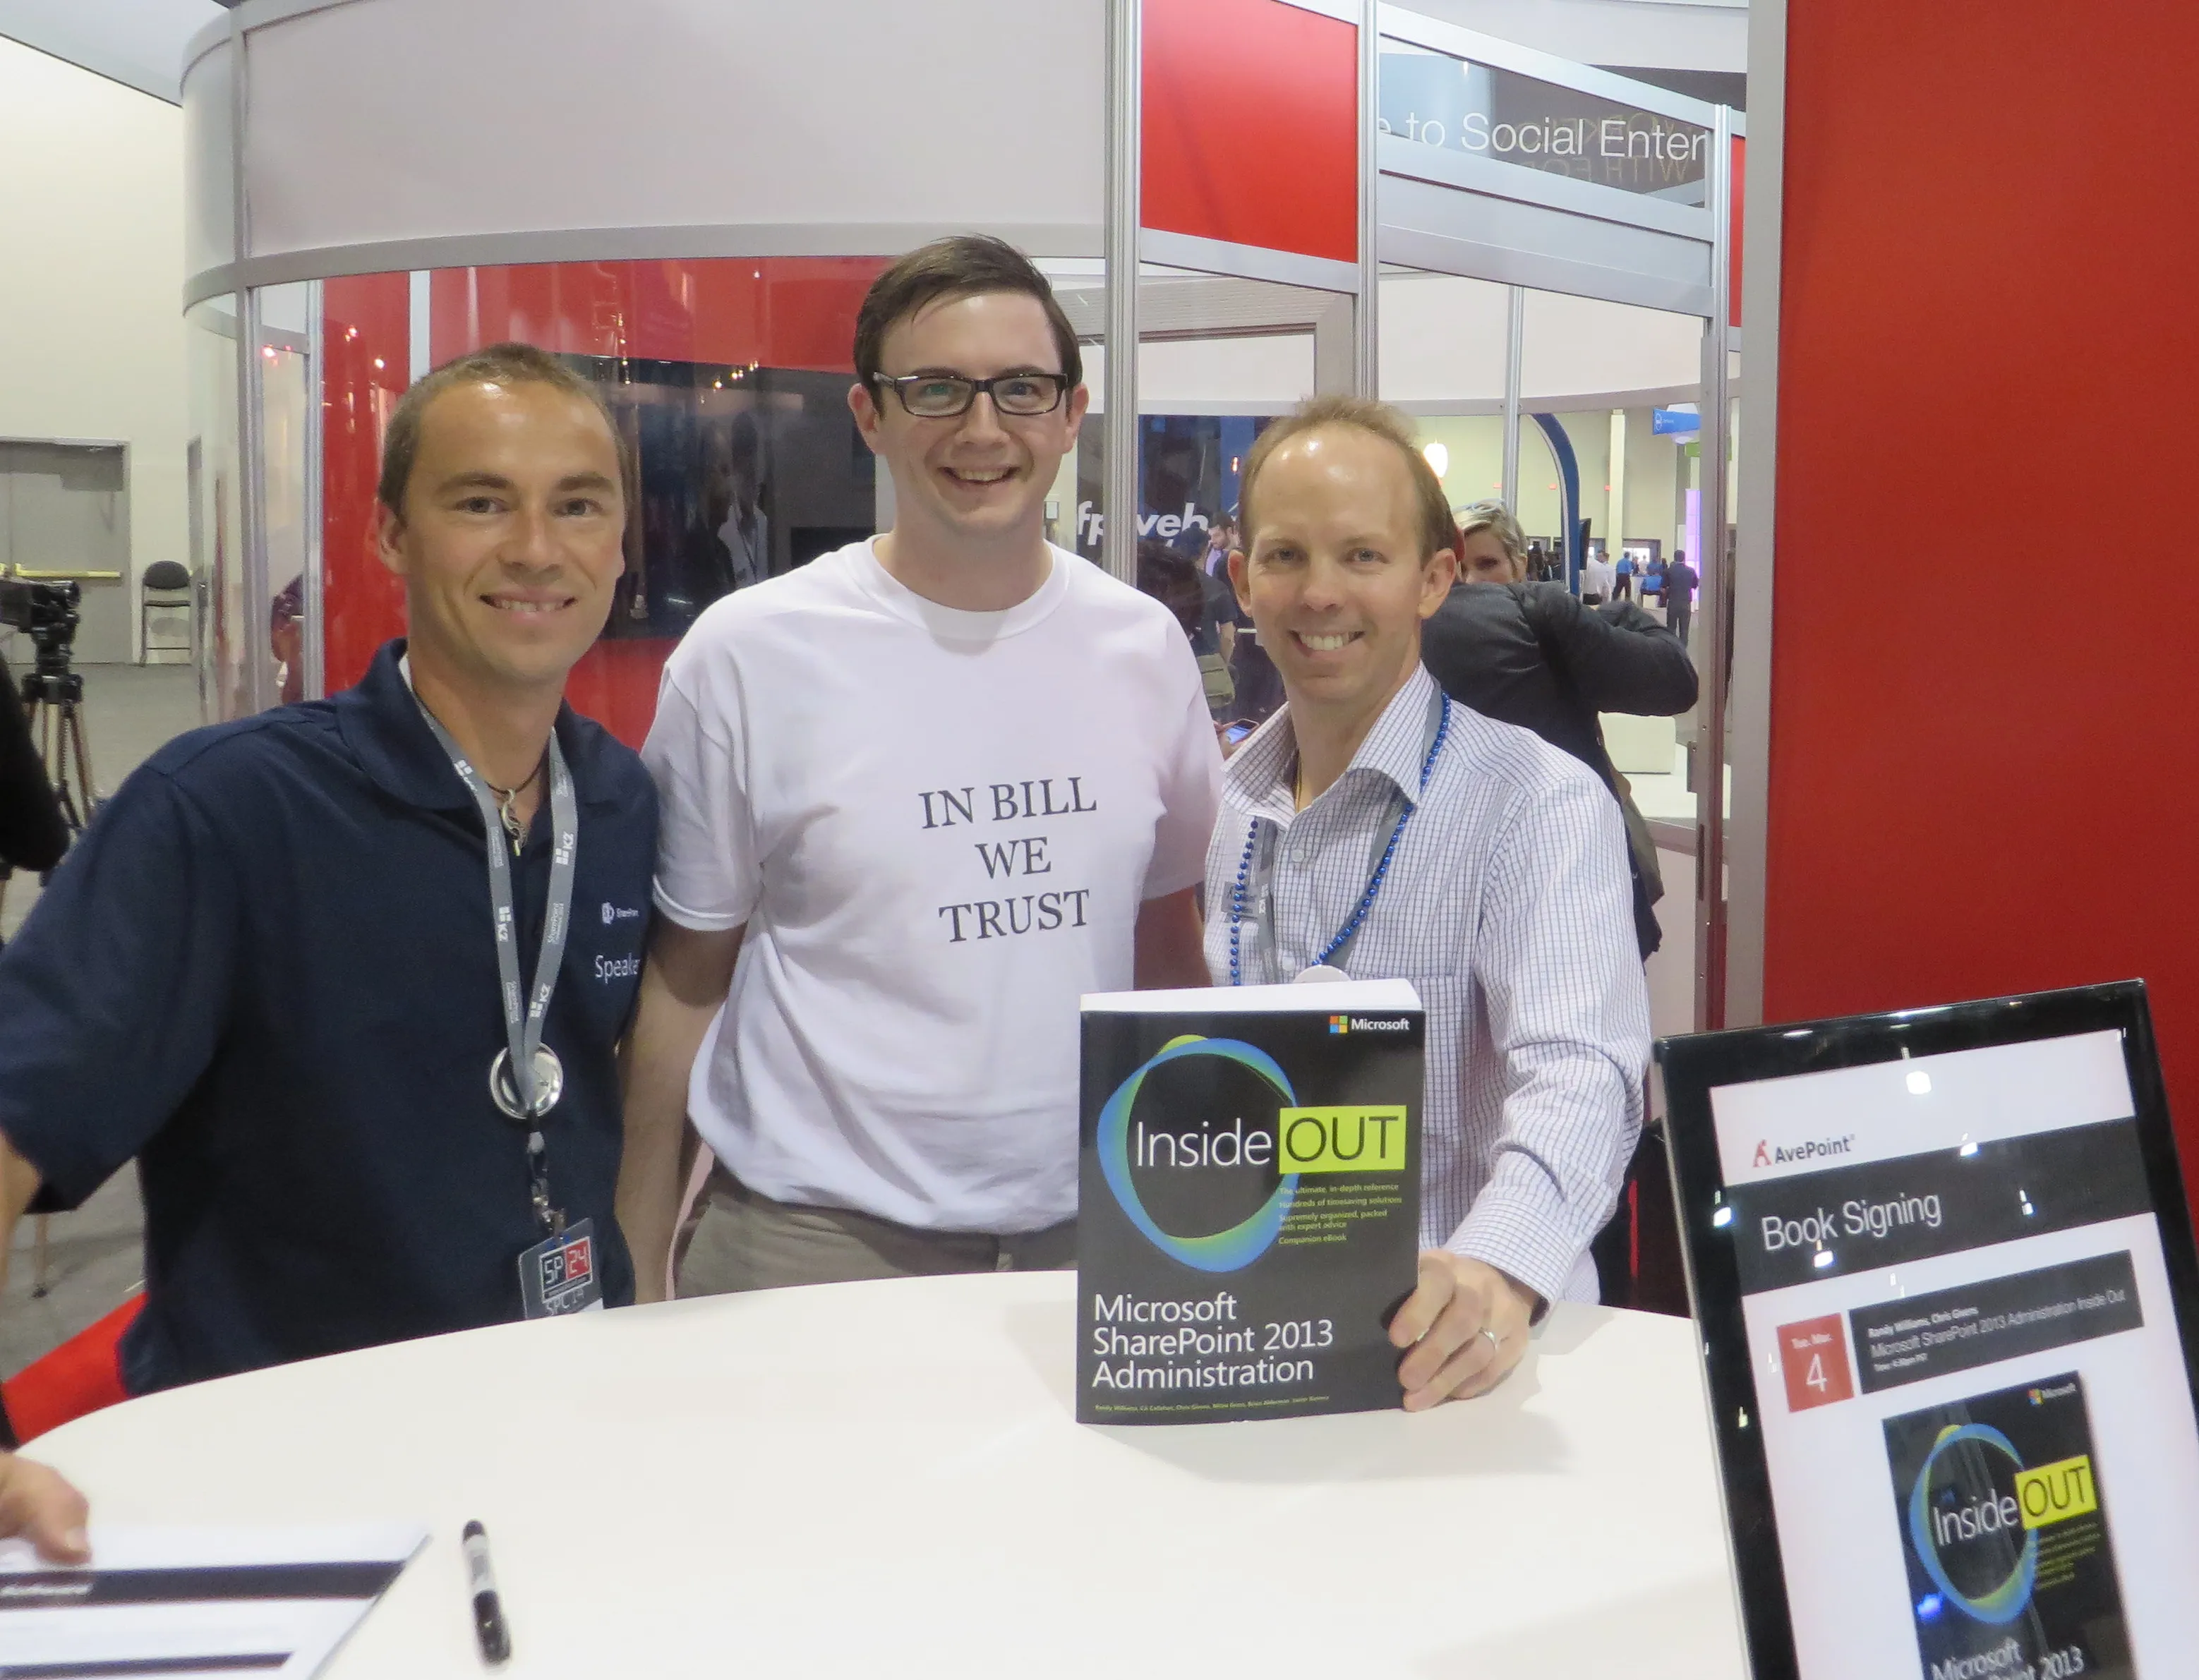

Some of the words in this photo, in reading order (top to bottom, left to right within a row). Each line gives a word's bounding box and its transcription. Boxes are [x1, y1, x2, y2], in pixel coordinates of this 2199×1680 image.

[1405, 111, 1445, 147] to
[1462, 112, 1583, 155] Social
[1600, 119, 1706, 161] Enter
[918, 787, 975, 829] IN
[989, 776, 1097, 821] BILL
[975, 836, 1051, 879] WE
[939, 889, 1089, 943] TRUST
[1351, 1017, 1409, 1032] Microsoft
[1136, 1118, 1272, 1168] Inside
[1285, 1116, 1399, 1162] OUT
[1761, 1207, 1838, 1250] Book
[1842, 1192, 1941, 1238] Signing
[1094, 1291, 1237, 1323] Microsoft
[1093, 1325, 1255, 1356] SharePoint
[1263, 1319, 1334, 1351] 2013
[1092, 1355, 1314, 1389] Administration
[1807, 1353, 1828, 1392] 4
[1933, 1488, 2019, 1547] Inside
[2023, 1466, 2086, 1517] OUT
